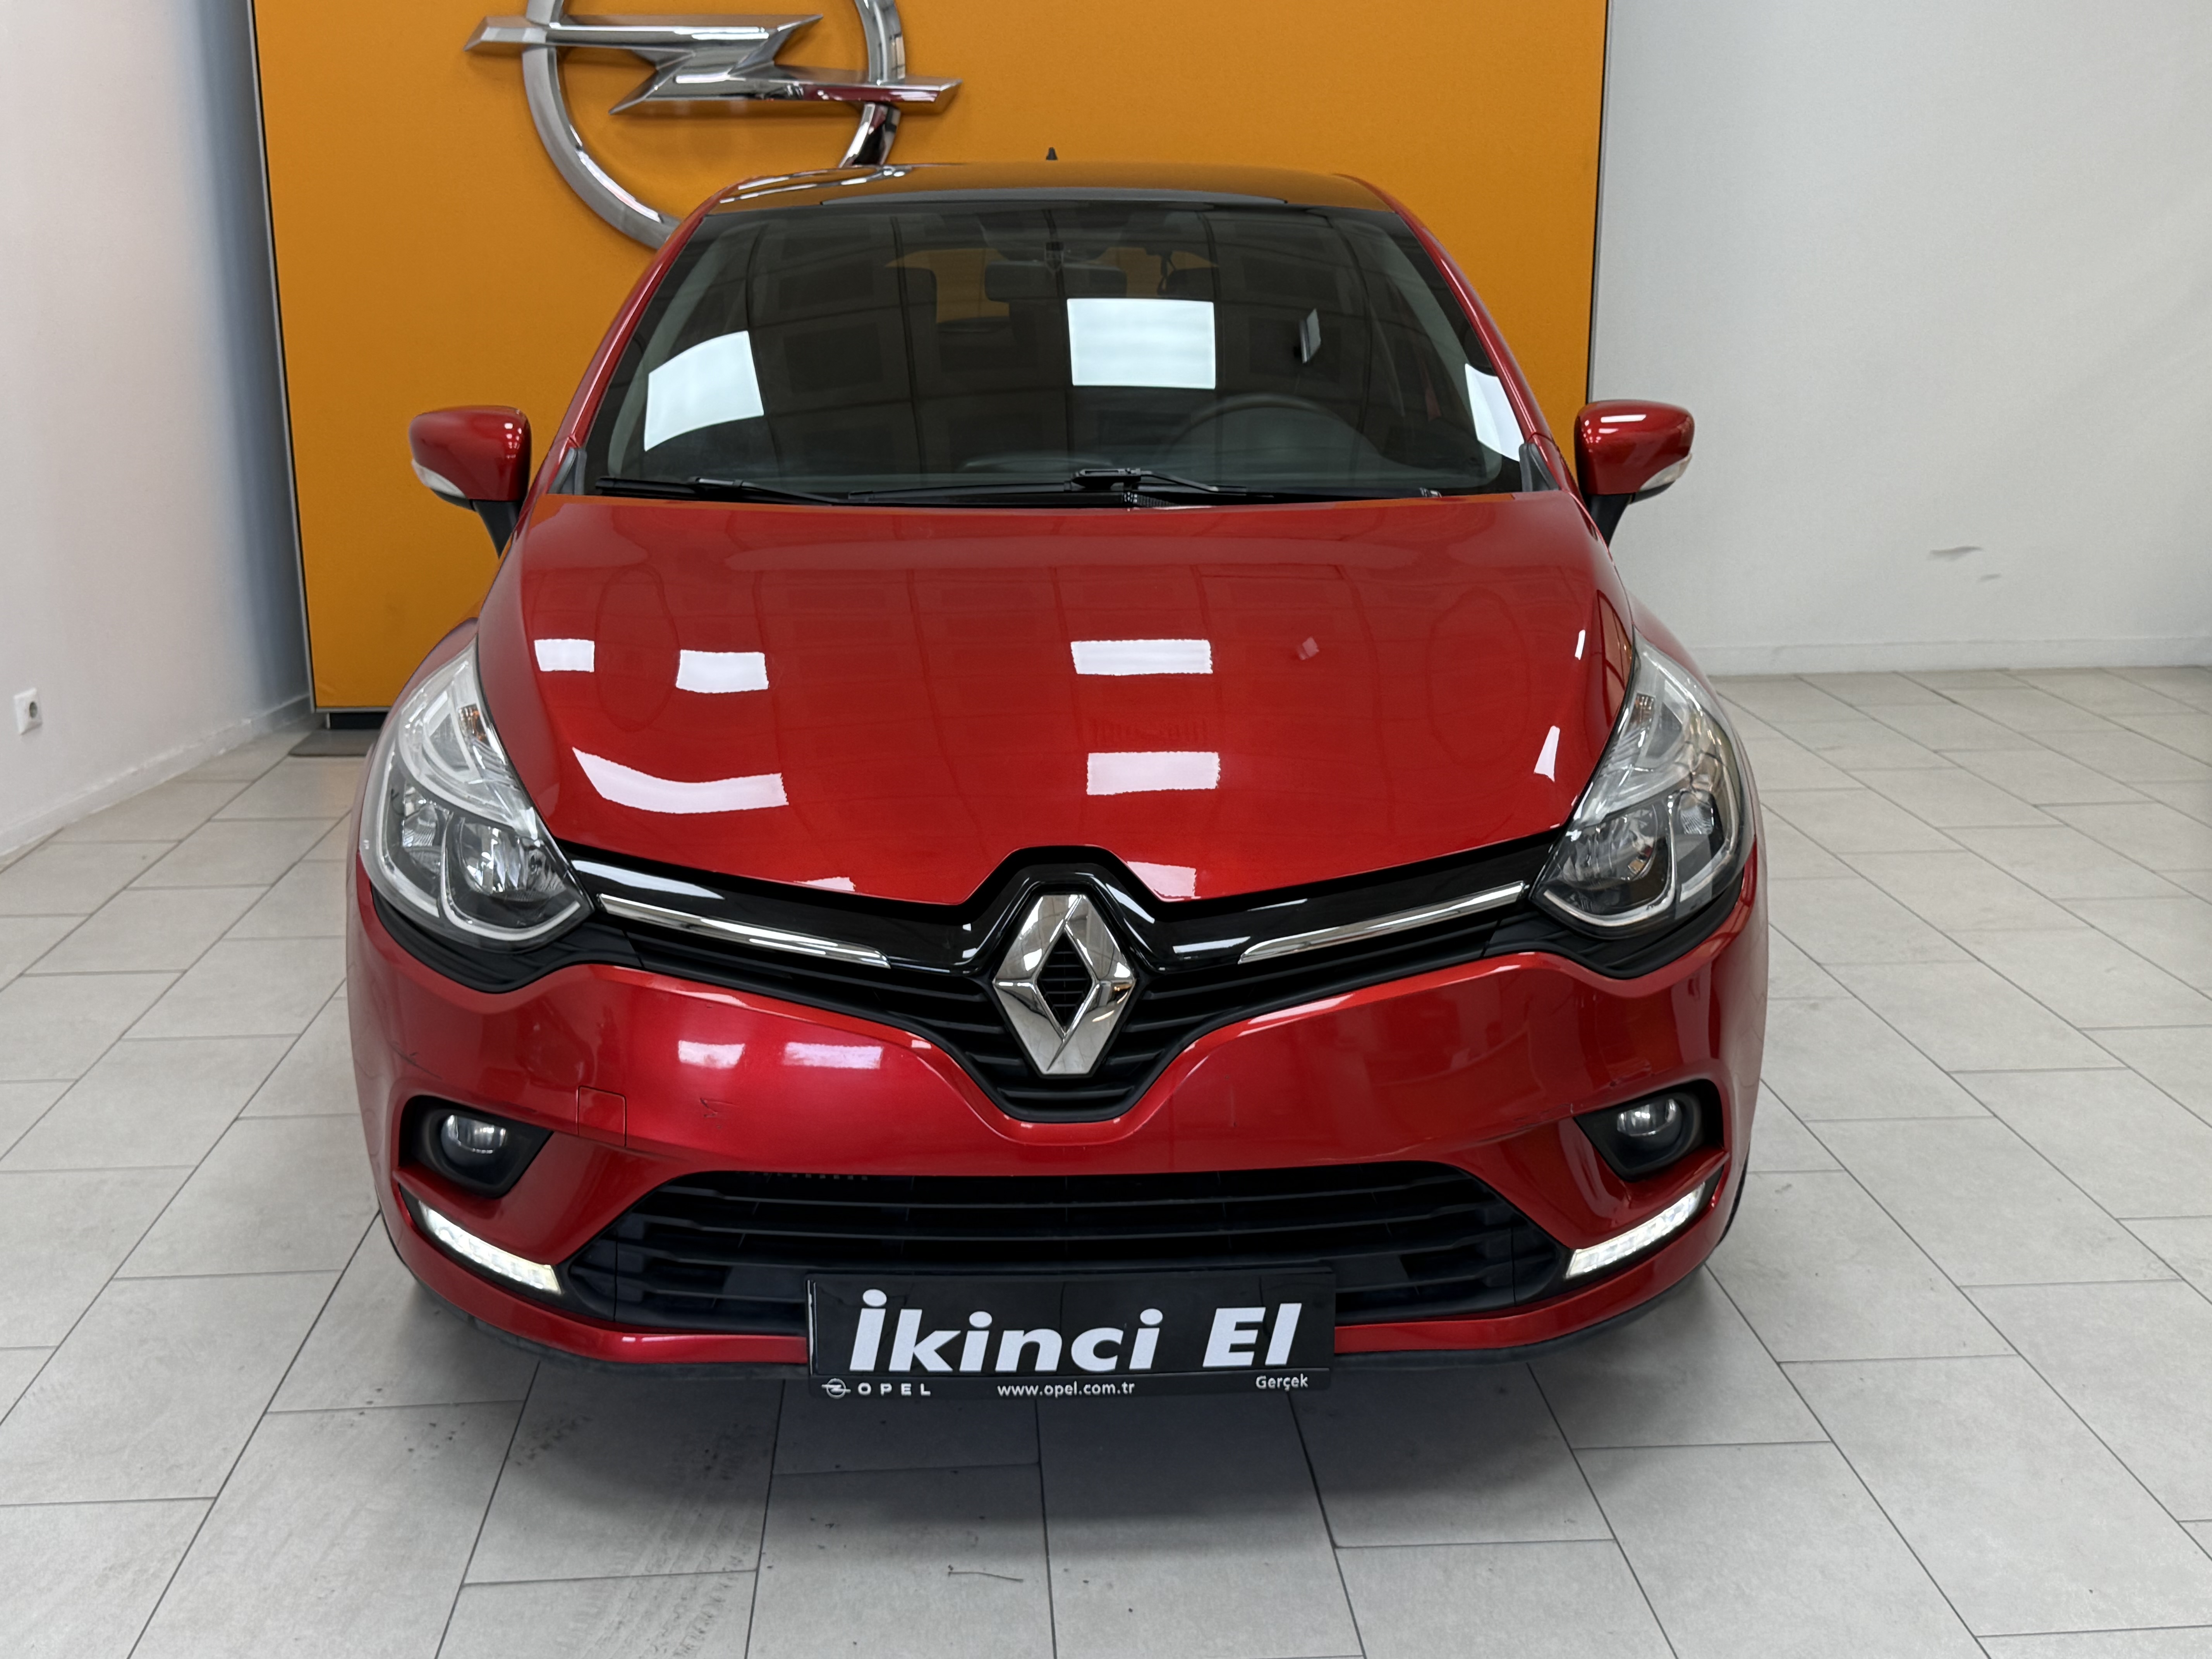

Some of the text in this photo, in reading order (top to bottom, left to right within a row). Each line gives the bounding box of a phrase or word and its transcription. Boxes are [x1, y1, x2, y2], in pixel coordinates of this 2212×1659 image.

[849, 1289, 1302, 1372] İkinci El
[857, 1382, 932, 1396] OPEL
[997, 1380, 1135, 1398] www.opel.com.tr
[1255, 1373, 1309, 1392] Gerçek
